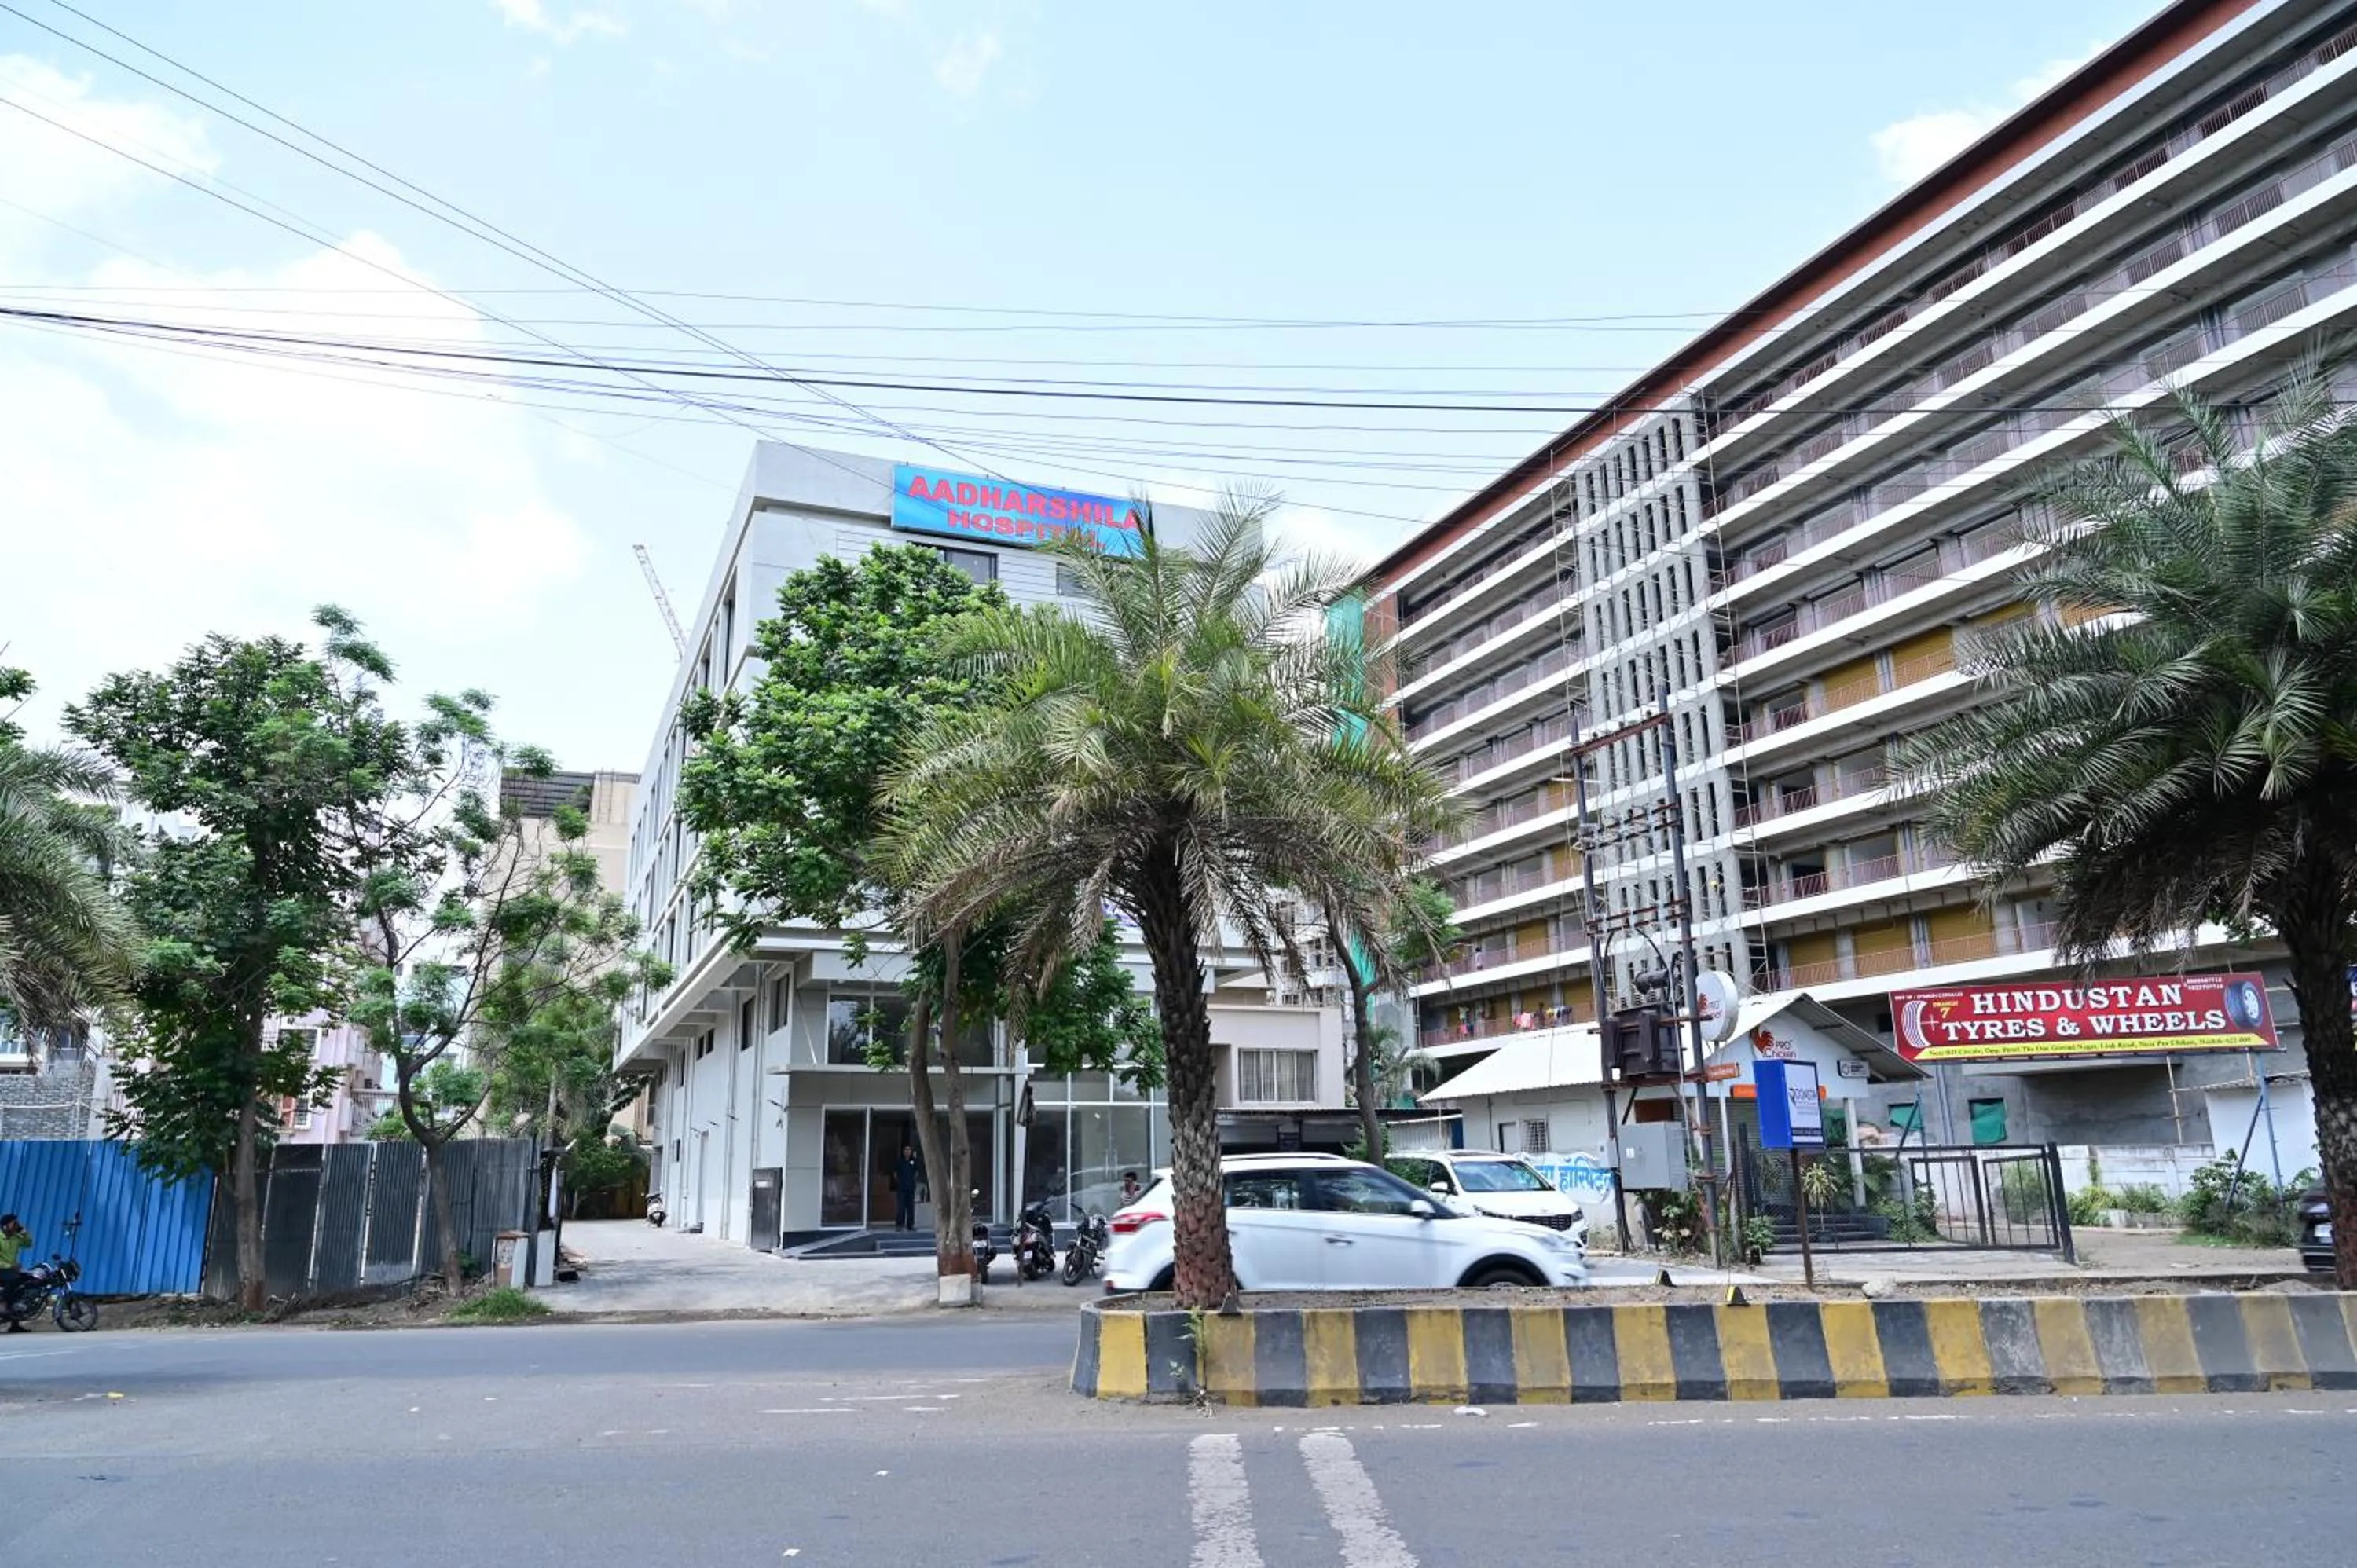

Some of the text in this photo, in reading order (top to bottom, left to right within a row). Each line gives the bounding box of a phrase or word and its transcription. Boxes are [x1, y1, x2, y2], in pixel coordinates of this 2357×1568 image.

[908, 475, 1142, 529] AADHARSHILA
[948, 509, 1106, 548] HOSPITL
[1970, 984, 2183, 1014] HINDUSTAN
[1942, 1009, 2226, 1041] TYRES & WHEELS
